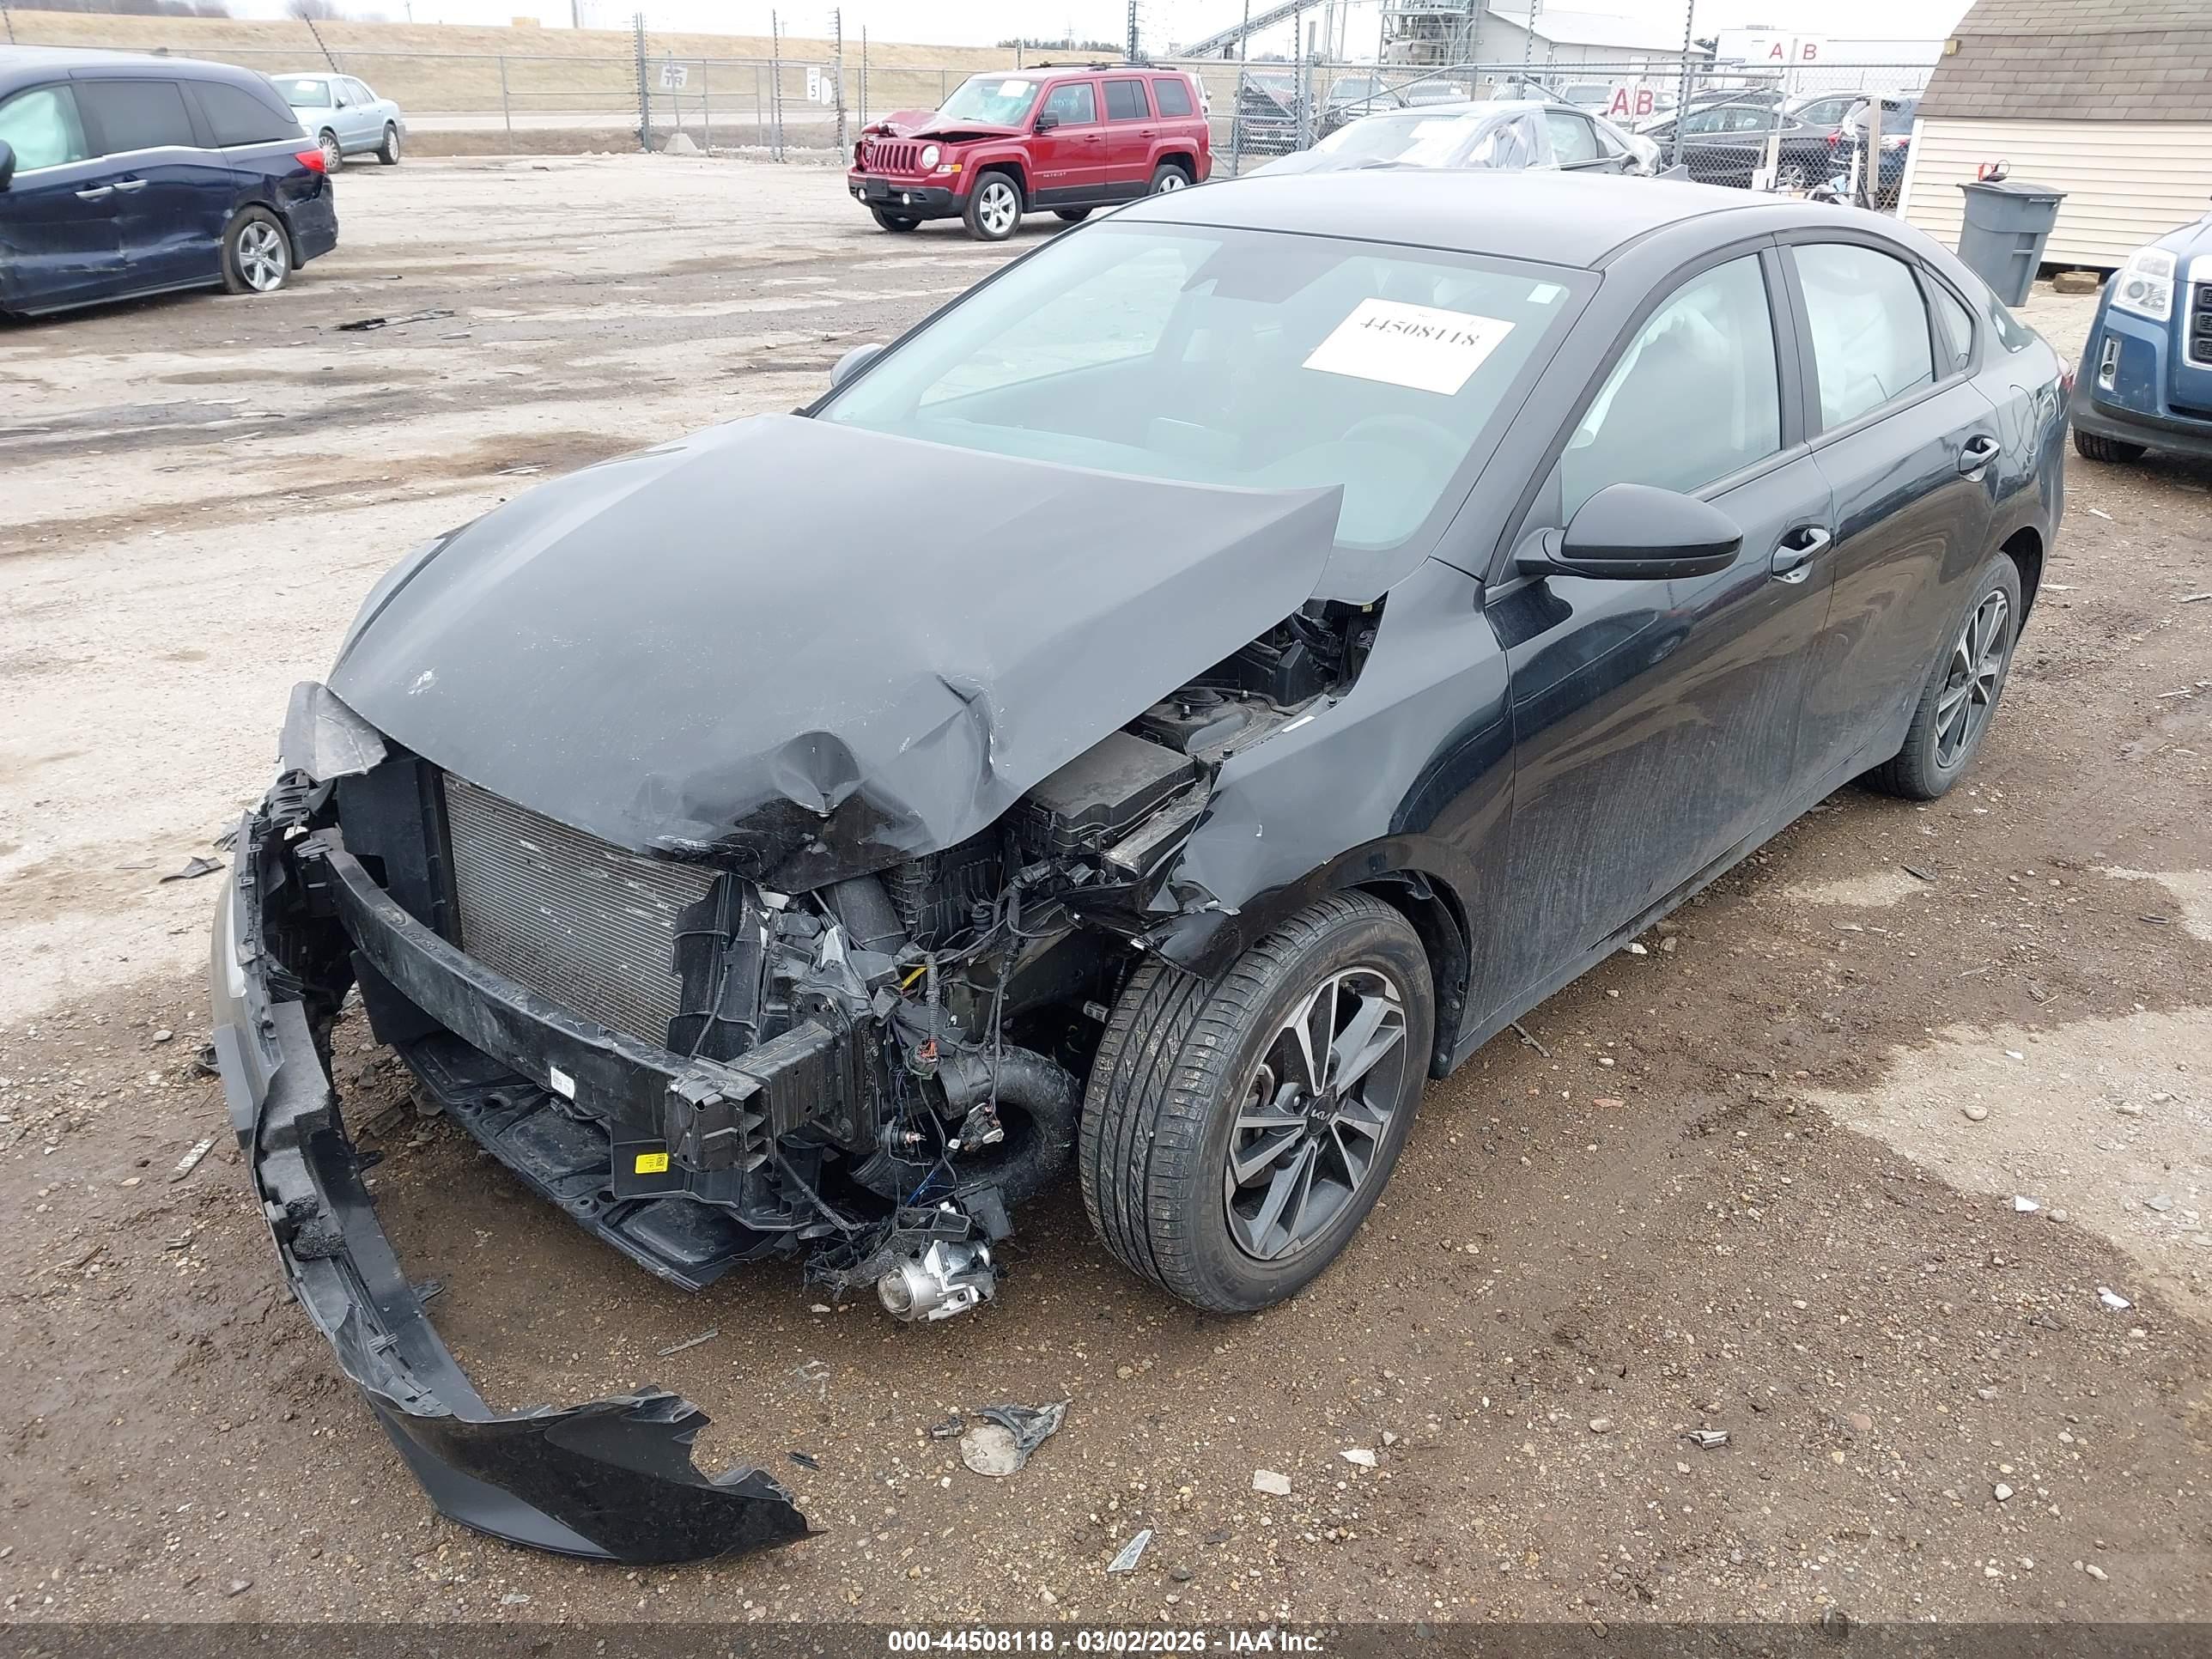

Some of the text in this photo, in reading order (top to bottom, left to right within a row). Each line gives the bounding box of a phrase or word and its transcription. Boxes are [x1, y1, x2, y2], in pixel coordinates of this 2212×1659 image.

[1769, 43, 1817, 60] A B
[811, 84, 817, 97] 5
[1610, 88, 1654, 115] A B
[1359, 317, 1480, 346] 44508118
